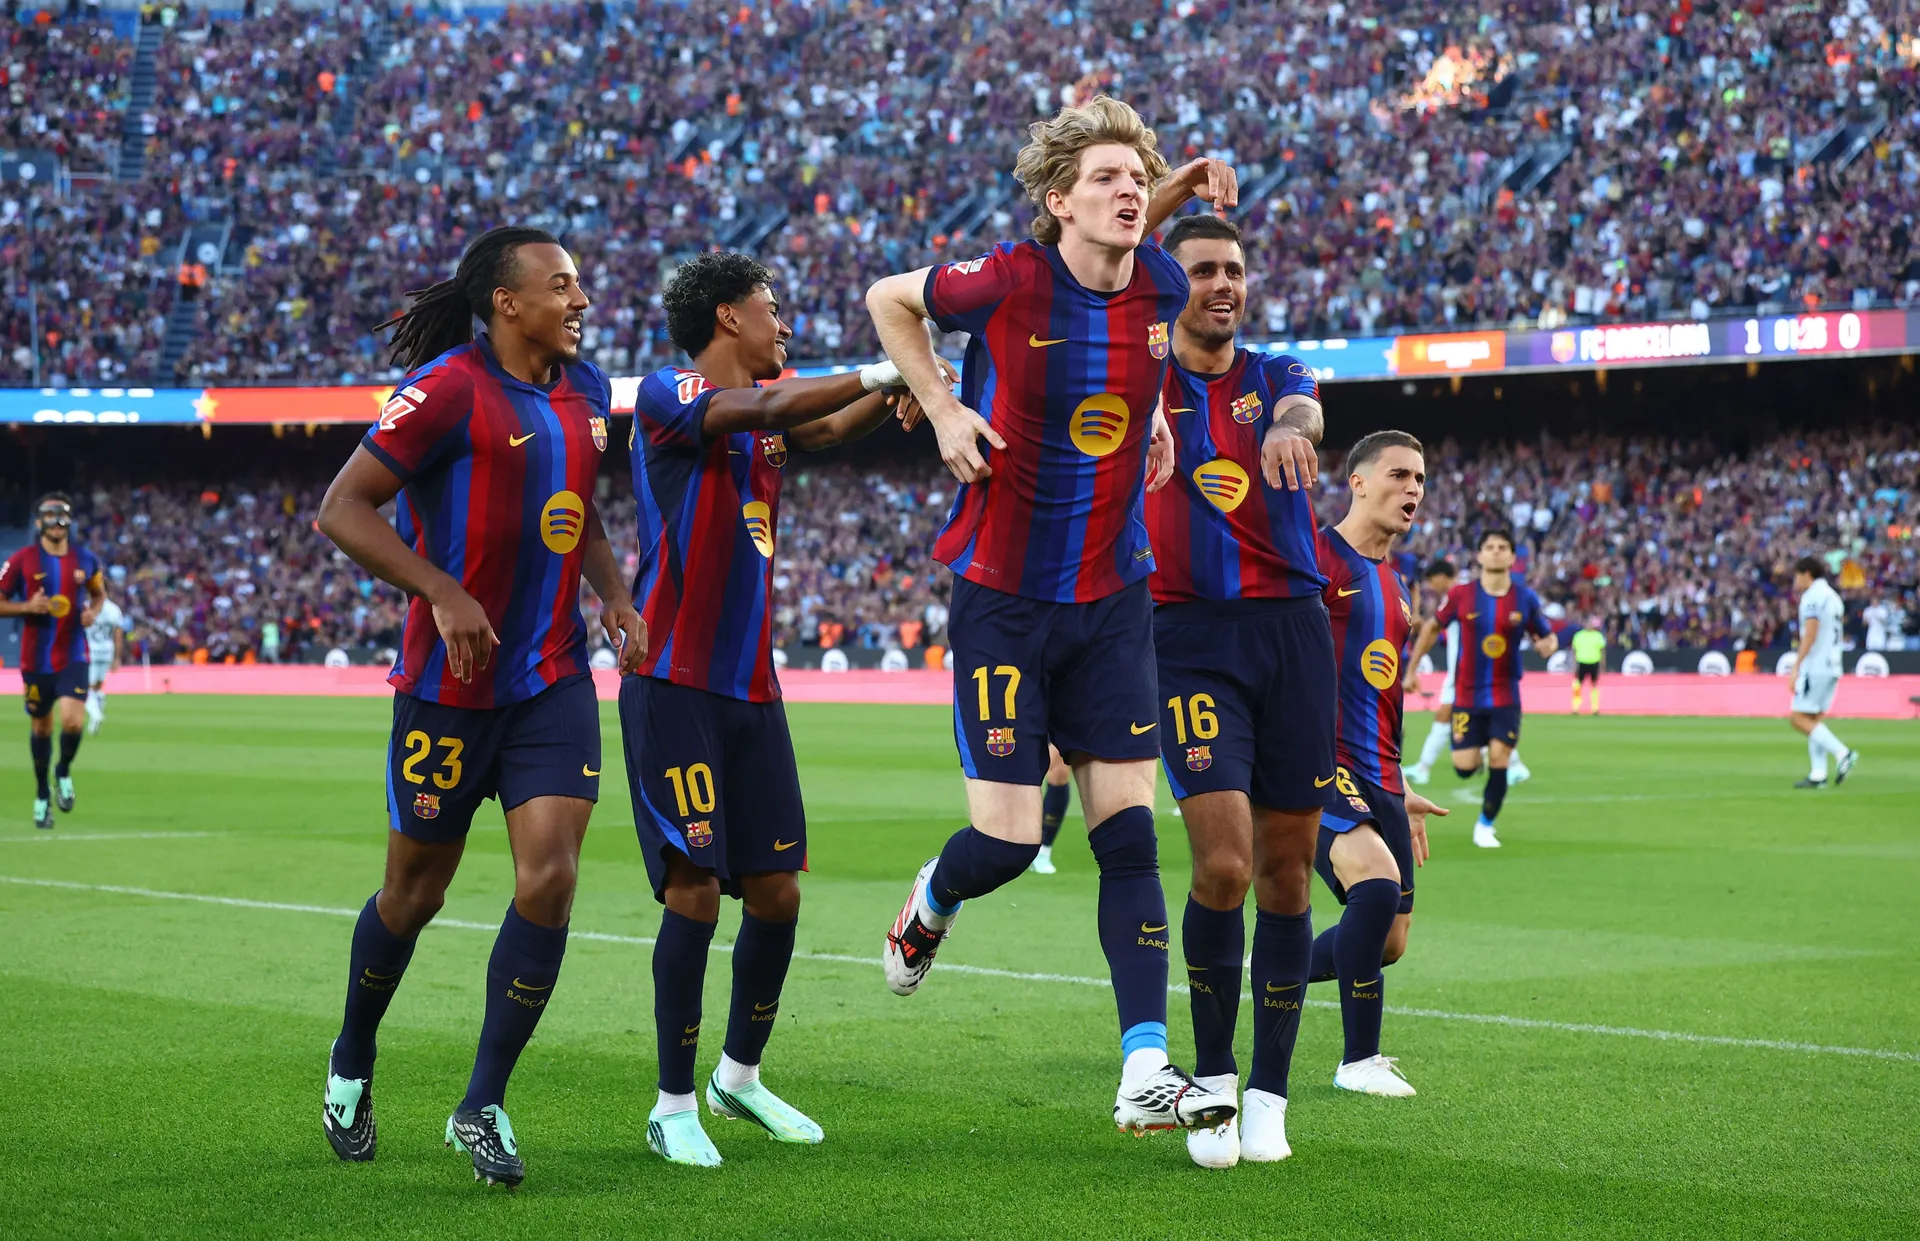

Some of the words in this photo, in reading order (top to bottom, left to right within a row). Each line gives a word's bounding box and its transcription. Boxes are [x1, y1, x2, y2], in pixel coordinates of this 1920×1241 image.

[1580, 328, 1605, 361] FC
[1605, 323, 1711, 359] BARCELONA
[1744, 318, 1762, 354] 1
[1838, 312, 1861, 349] 0
[972, 665, 1021, 721] 17
[1167, 692, 1219, 745] 16
[402, 730, 464, 790] 23
[664, 762, 716, 817] 10
[1335, 766, 1360, 796] 6
[506, 989, 545, 1008] BARÇA
[1187, 977, 1213, 995] ARÇA
[1264, 997, 1300, 1011] BARÇA
[1351, 990, 1379, 1001] BARÇA
